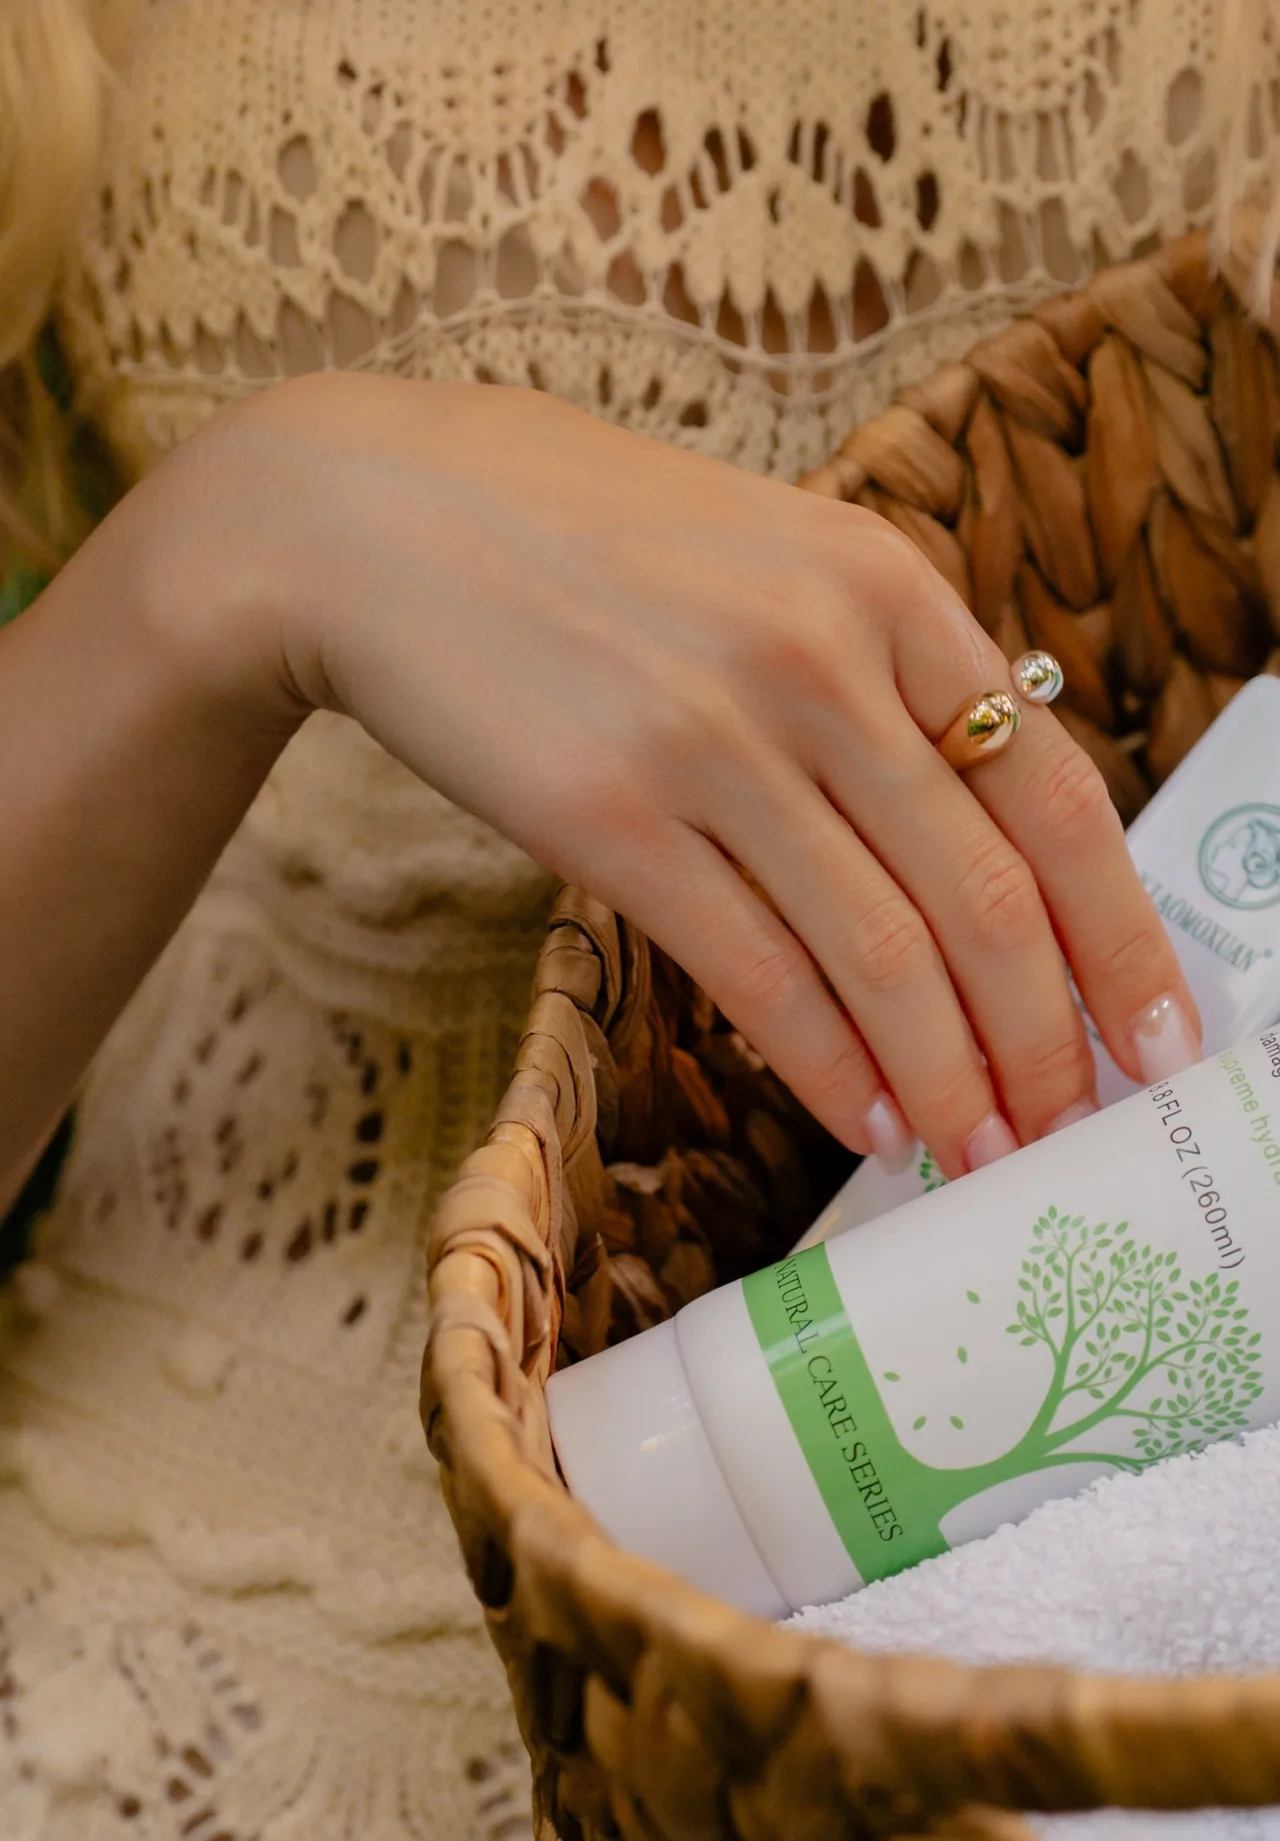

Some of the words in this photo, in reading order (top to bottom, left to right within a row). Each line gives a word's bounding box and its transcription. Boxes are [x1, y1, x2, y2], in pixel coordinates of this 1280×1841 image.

[1181, 1166, 1246, 1270] (260ml)
[773, 1257, 820, 1354] NATURAL
[807, 1354, 858, 1440] CARE
[841, 1440, 904, 1543] SERIES
